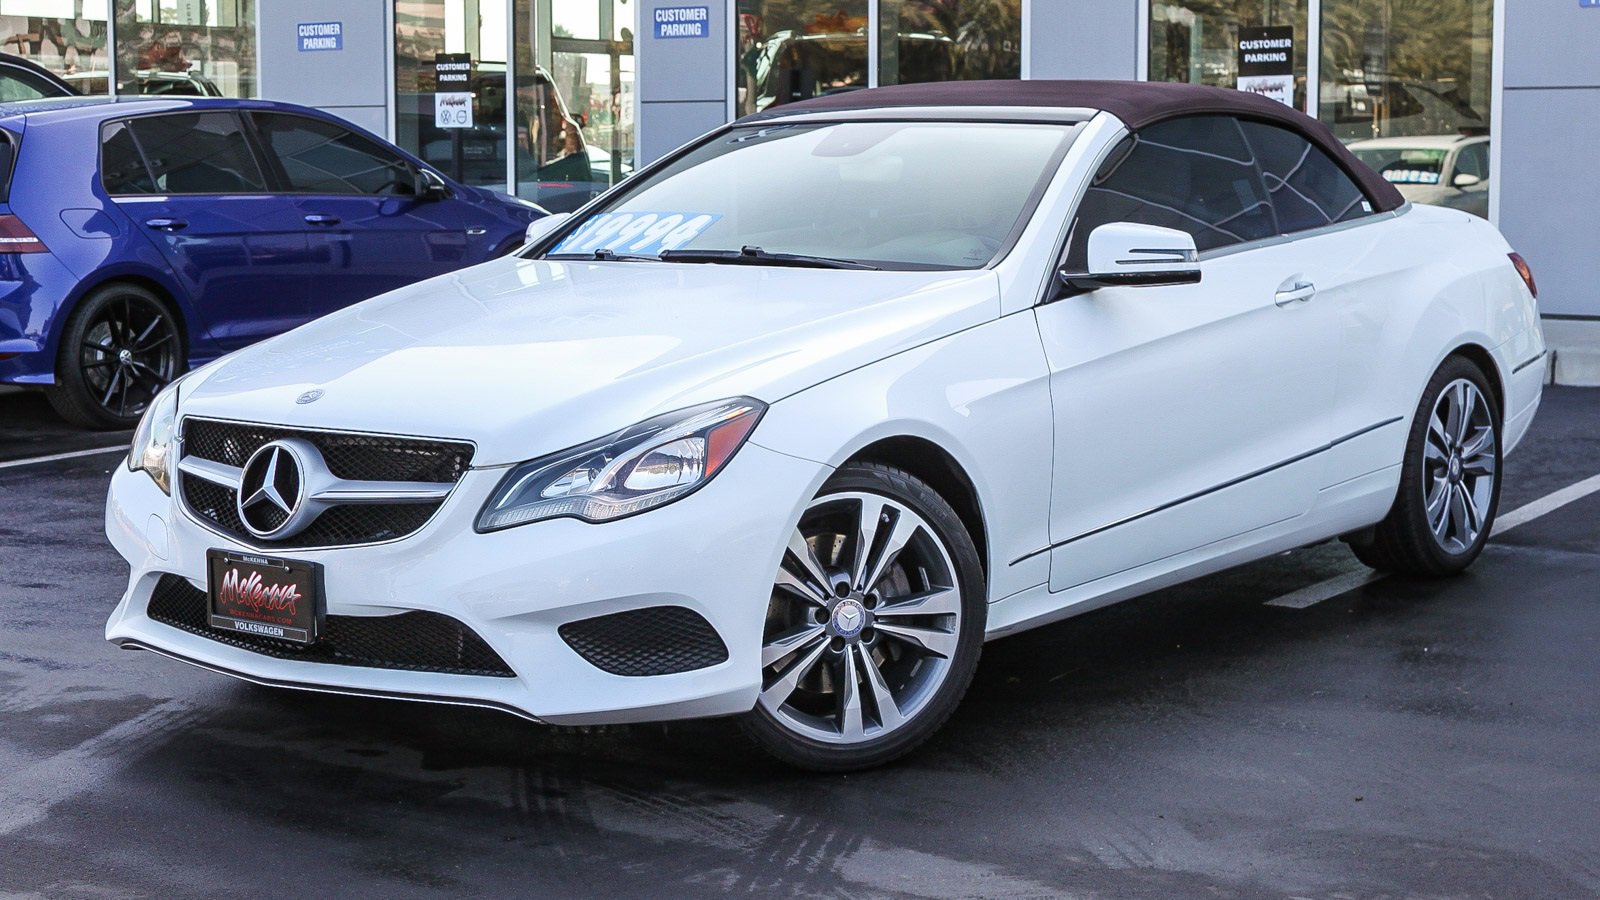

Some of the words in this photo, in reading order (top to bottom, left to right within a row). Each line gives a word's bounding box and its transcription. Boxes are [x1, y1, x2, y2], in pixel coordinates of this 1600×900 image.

[655, 8, 706, 22] CUSTOMER
[299, 23, 340, 36] CUSTOMER
[660, 23, 702, 36] PARKING
[303, 37, 336, 49] PARKING
[1239, 39, 1292, 49] CUSTOMER
[1244, 52, 1287, 63] PARKING
[436, 63, 470, 71] CUSTOMER
[439, 74, 467, 82] PARKING
[234, 620, 284, 637] VOLKSWAGEN
